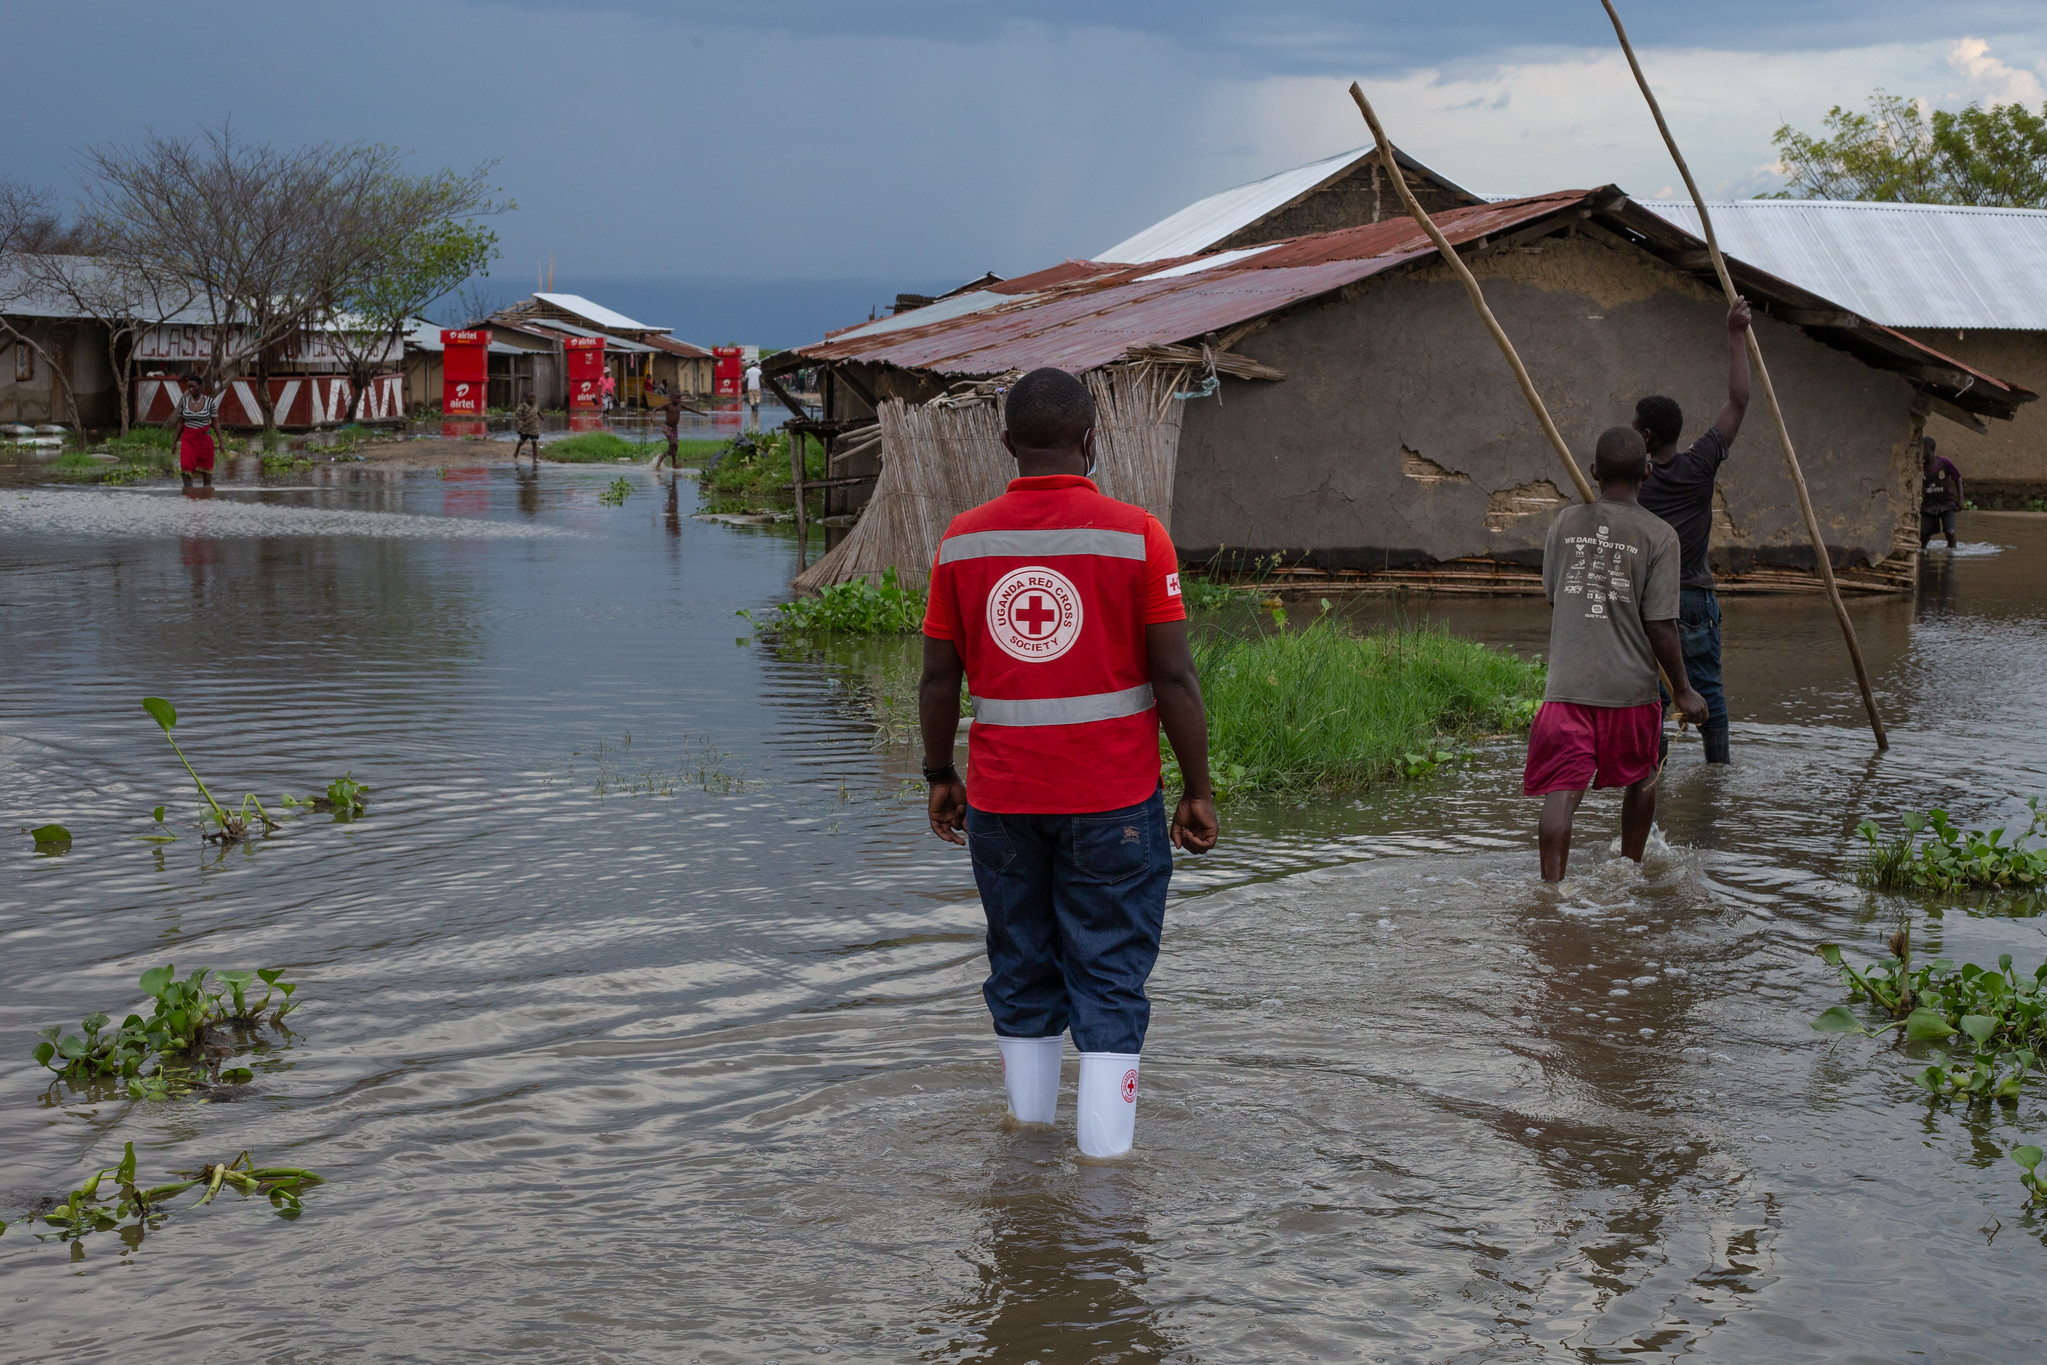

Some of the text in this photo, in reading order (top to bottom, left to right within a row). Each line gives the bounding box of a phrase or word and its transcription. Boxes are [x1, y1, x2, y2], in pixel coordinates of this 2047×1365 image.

[457, 331, 477, 339] airtel
[578, 338, 596, 346] airtel
[450, 398, 474, 408] airtel
[1576, 537, 1597, 545] DARE
[1598, 540, 1614, 548] YOU
[1626, 545, 1639, 554] TRI
[997, 577, 1073, 628] UGANDA RED CROSS
[1010, 636, 1058, 651] SOCIETY
